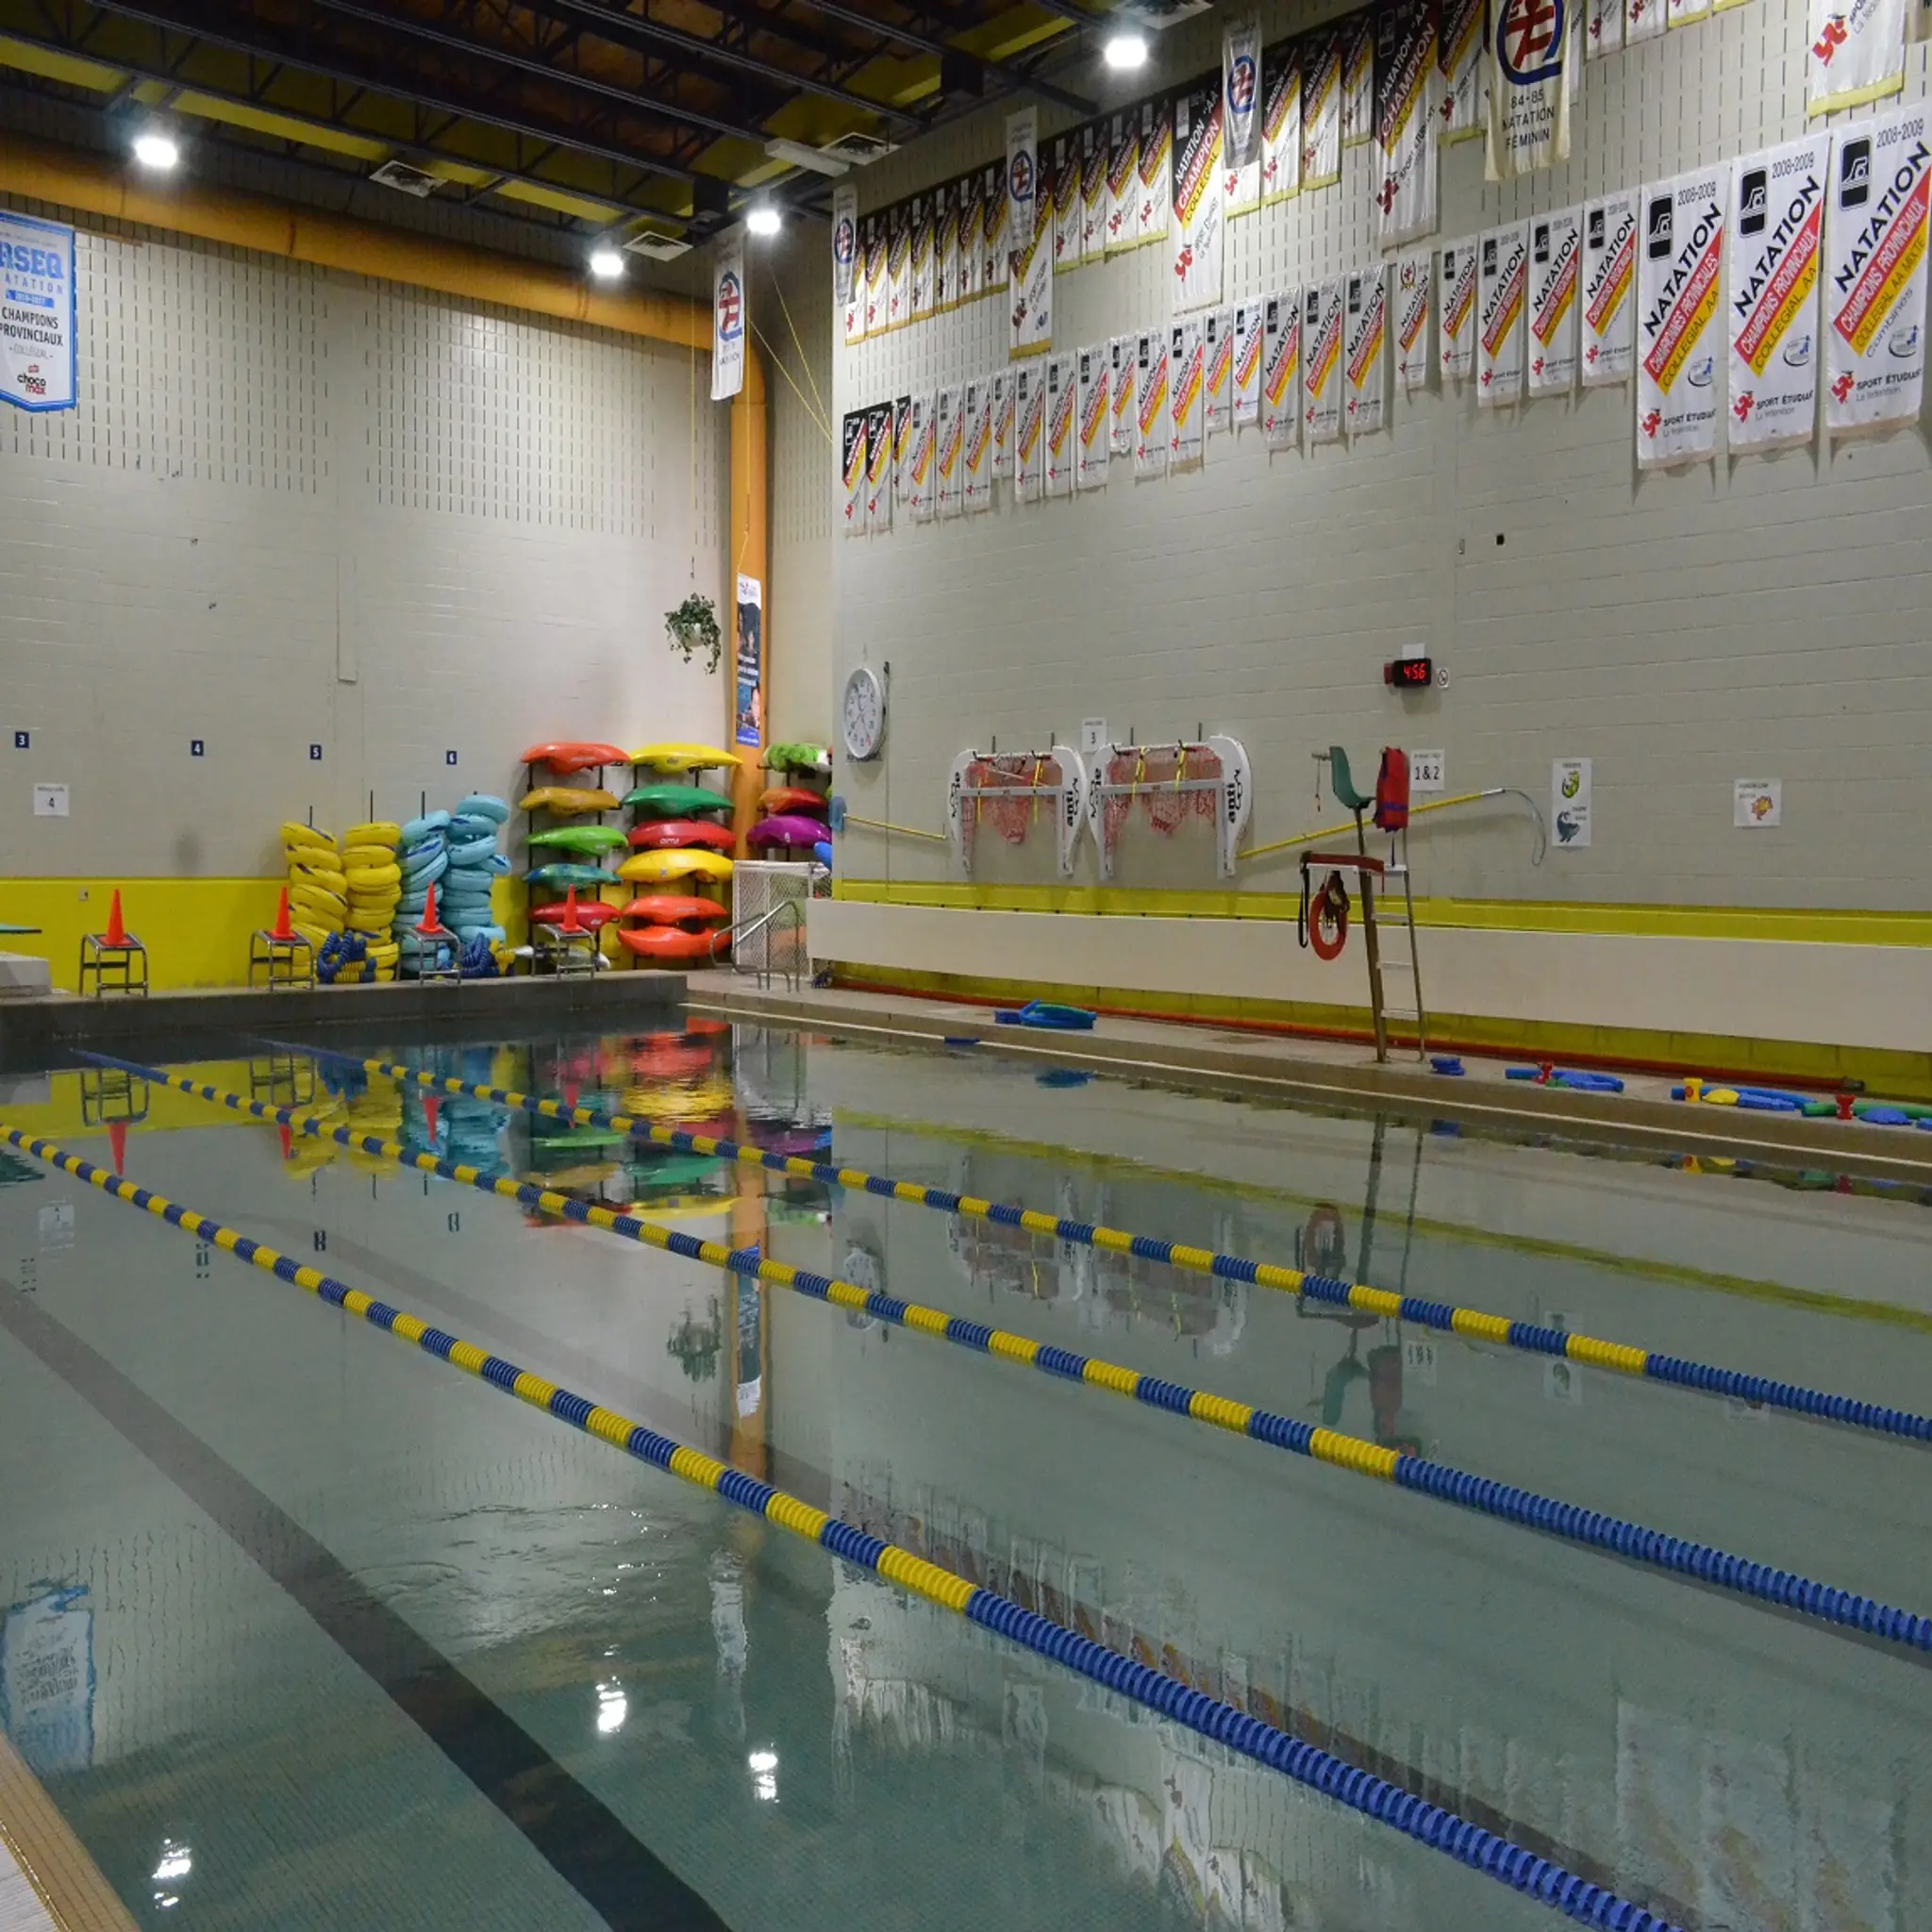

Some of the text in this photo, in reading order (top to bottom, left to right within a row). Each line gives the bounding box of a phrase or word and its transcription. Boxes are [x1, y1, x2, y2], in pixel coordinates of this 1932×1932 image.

[1379, 33, 1414, 104] NATATION
[1381, 23, 1435, 138] CHAMPION
[1511, 87, 1544, 109] 84-85
[1174, 119, 1207, 185] NATATION
[1502, 106, 1555, 132] NATATION
[1876, 118, 1924, 148] 2008-2009
[1178, 119, 1220, 210] CHAMPION
[1772, 152, 1815, 179] 2008-2009
[1734, 175, 1820, 318] NATATION
[1834, 141, 1931, 293] NATATION
[0, 242, 64, 279] RSEQ
[5, 271, 63, 294] ATATION
[1443, 256, 1475, 315] NATATION
[1482, 242, 1524, 325] NATATION
[1533, 229, 1578, 312] NATATION
[1587, 213, 1635, 299] NATATION
[1643, 202, 1723, 338] NATATION
[1840, 196, 1926, 332] CHAMPIONS PROVINCIAUX
[2, 307, 58, 329] CHAMPIONS
[1347, 282, 1385, 358] NATATION
[1740, 228, 1818, 355] CHAMPIONS PROVINCIAUX
[1236, 313, 1260, 367] NATATION
[1266, 304, 1298, 376] NATATION
[1306, 293, 1341, 368] NATATION
[1662, 290, 1719, 388] COLLEGIAL AA
[1755, 294, 1804, 369] COLLEGIAL
[17, 373, 46, 386] choco
[1757, 397, 1779, 410] SPORT
[1857, 376, 1883, 391] SPORT
[19, 735, 25, 746] 3
[193, 742, 201, 754] 4
[312, 747, 320, 758] 5
